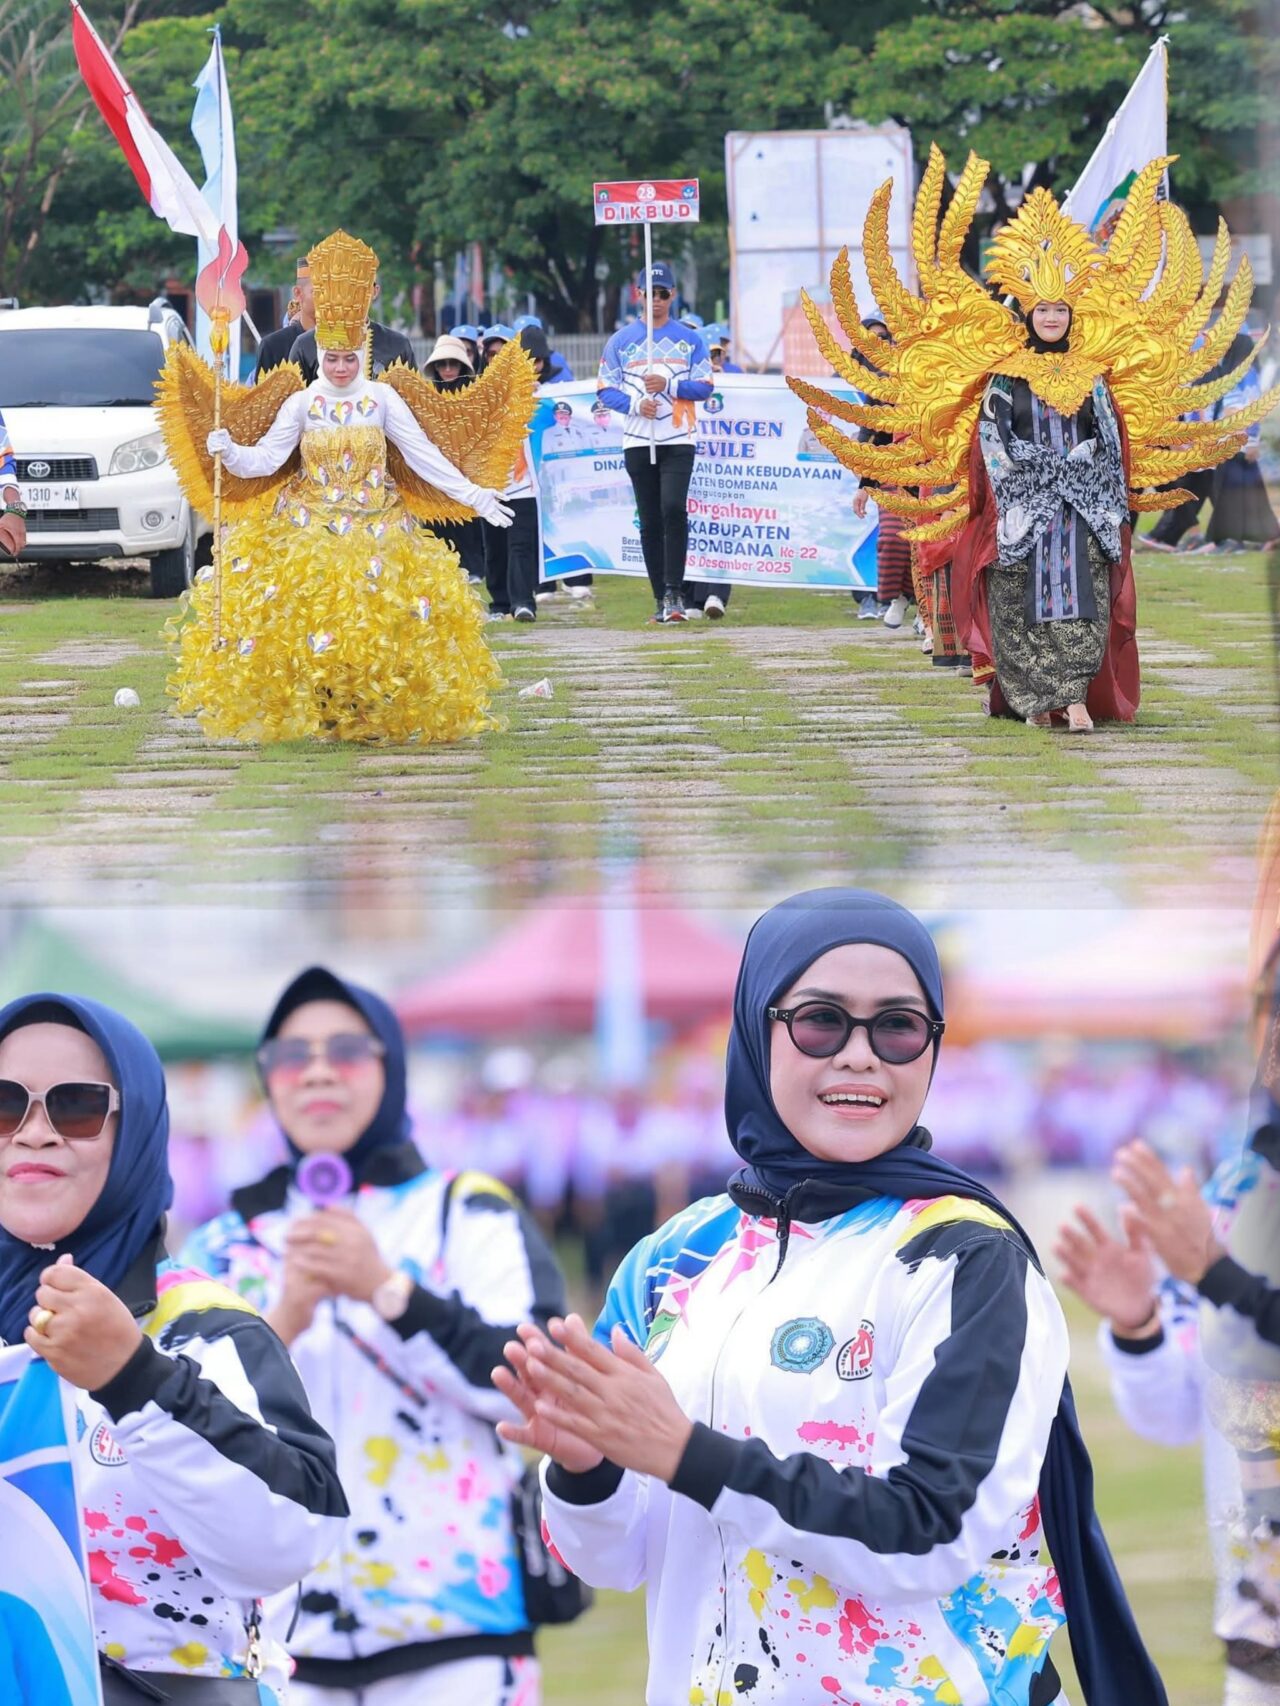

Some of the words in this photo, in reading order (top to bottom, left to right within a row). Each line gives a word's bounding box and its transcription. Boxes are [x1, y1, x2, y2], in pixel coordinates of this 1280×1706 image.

[639, 187, 653, 198] 28
[604, 205, 690, 220] DIKBUD
[698, 420, 783, 437] TINGEN
[696, 441, 755, 458] EVILE
[594, 460, 626, 471] DINA
[714, 464, 742, 476] DAN
[746, 466, 842, 480] KEBUDAYAAN
[691, 477, 716, 487] ATEN
[718, 479, 778, 491] BOMBANA
[28, 488, 50, 501] 1310
[64, 488, 78, 501] AK
[688, 499, 777, 523] Dirgahayu
[688, 519, 790, 540] KABUPATEN
[687, 537, 774, 557] BOMBANA
[756, 561, 792, 573] 2025
